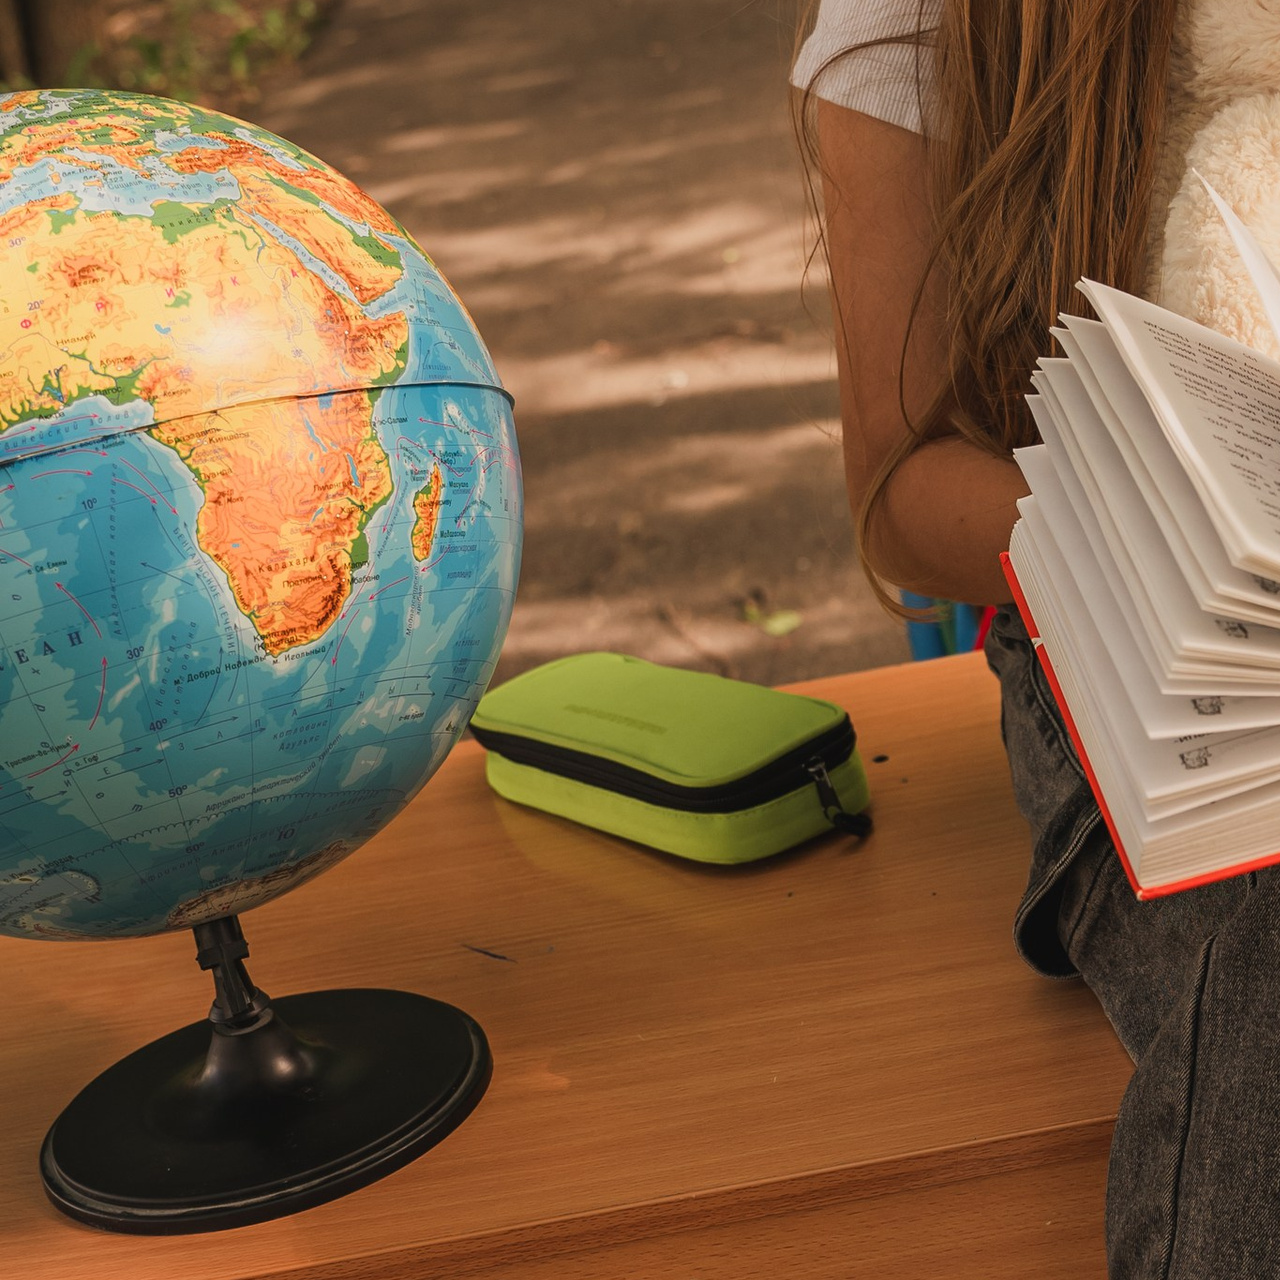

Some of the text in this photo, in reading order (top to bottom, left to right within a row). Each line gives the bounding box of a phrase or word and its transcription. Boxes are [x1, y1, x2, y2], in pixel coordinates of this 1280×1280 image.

[56, 333, 97, 347] Ниамей
[0, 422, 79, 451] винейский
[81, 498, 98, 511] 10°
[126, 646, 145, 660] 30°
[284, 645, 327, 663] Игольный
[186, 666, 222, 684] Доброй
[225, 655, 268, 671] Надежды
[149, 718, 168, 733] 40°
[168, 784, 188, 799] 50°
